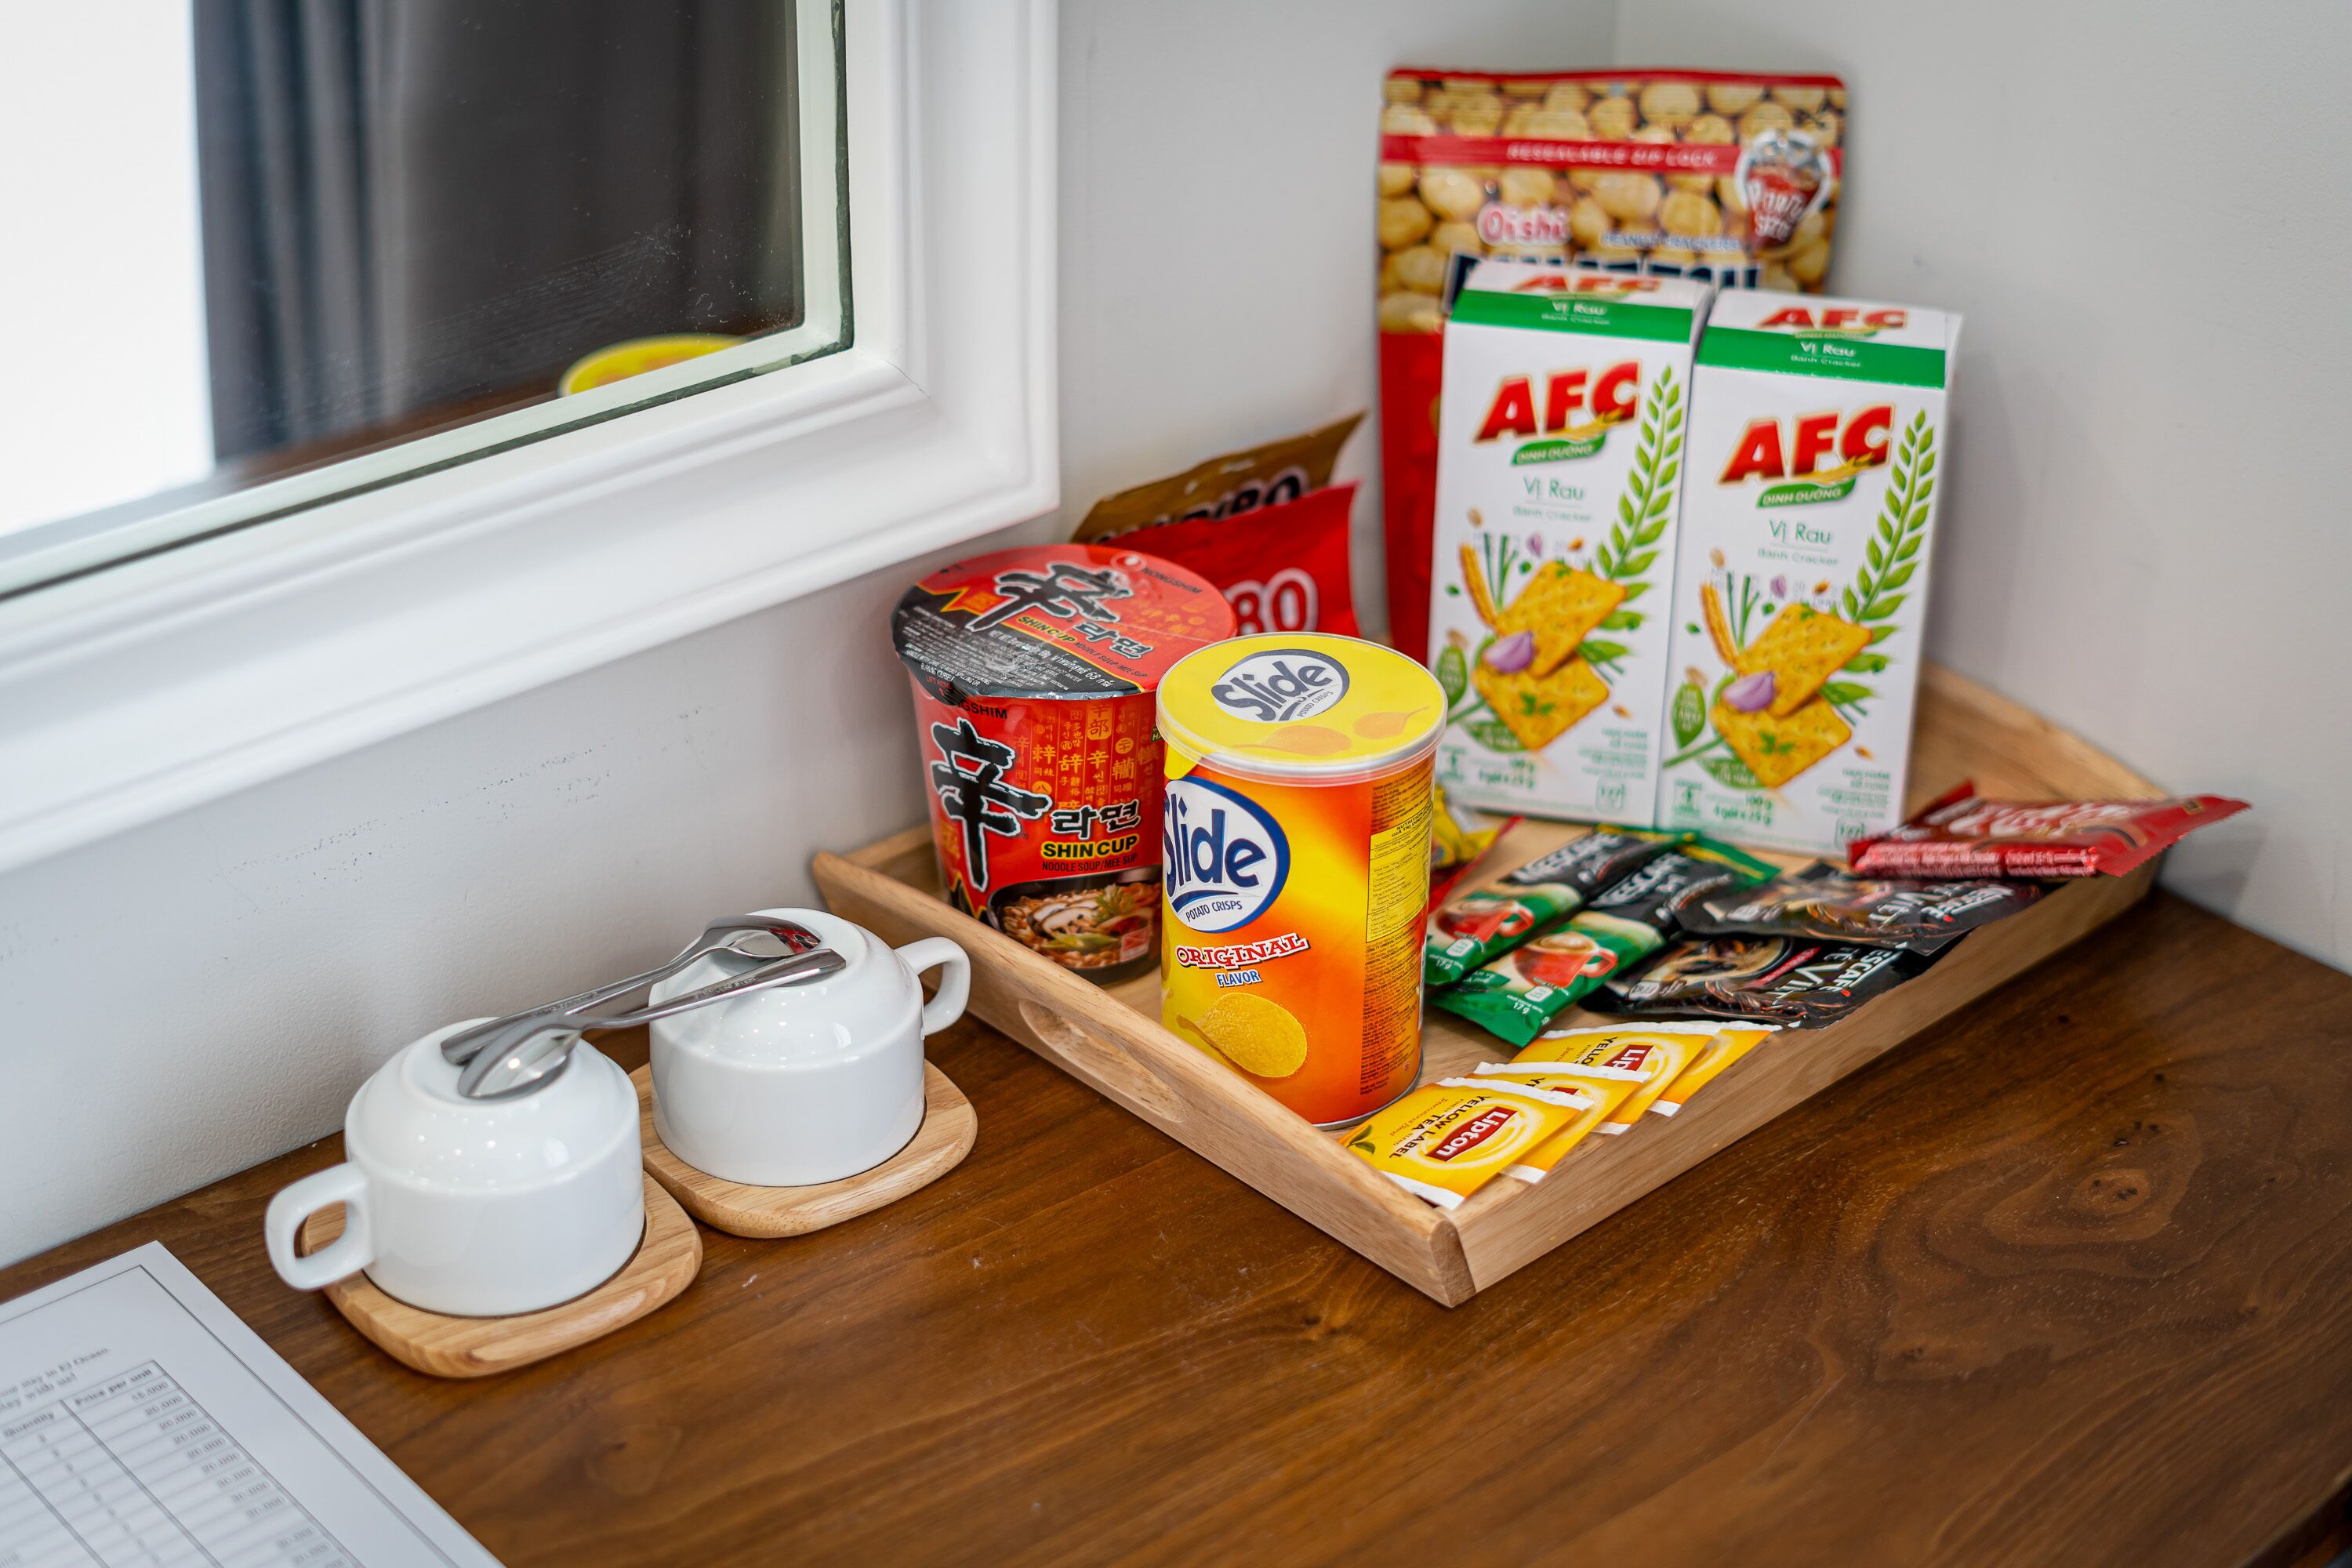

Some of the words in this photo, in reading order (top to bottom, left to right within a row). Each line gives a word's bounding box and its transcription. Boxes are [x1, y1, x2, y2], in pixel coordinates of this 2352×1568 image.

[1479, 205, 1570, 245] Oishi
[1573, 302, 1606, 315] Rau
[1758, 307, 1907, 328] AFC
[1823, 343, 1856, 358] Rau
[1473, 360, 1643, 442] AFC
[1716, 401, 1895, 487] AFC
[1523, 476, 1541, 501] Vị
[1548, 478, 1584, 500] Rau
[1769, 517, 1787, 543] Vị
[1795, 521, 1831, 545] Rau
[1142, 567, 1203, 595] NONGSHIM
[1017, 615, 1050, 633] SHIN
[1047, 627, 1077, 644] CUP
[1073, 641, 1101, 659] NOODLE
[1211, 660, 1334, 721] Slide
[1297, 701, 1315, 717] POTATO
[1312, 690, 1334, 704] CRISPS
[931, 716, 1052, 893] 辛
[1051, 799, 1141, 840] 라면
[1041, 841, 1096, 859] SHIN
[1096, 833, 1140, 857] CUP
[1164, 793, 1267, 898] Slide
[1042, 860, 1076, 873] NOODLE
[1185, 903, 1210, 923] POTATO
[1211, 900, 1243, 913] CRISPS
[1176, 935, 1308, 968] ORIGINAL
[1216, 970, 1261, 987] FLAVOR
[1818, 948, 1894, 997] ESCAFÉ
[1614, 1048, 1646, 1071] Lip
[1411, 1113, 1446, 1131] TEA
[1431, 1094, 1493, 1130] YELLOW
[1388, 1131, 1436, 1159] LABEL
[1436, 1111, 1510, 1156] Lipton
[74, 1388, 106, 1406] Price
[107, 1378, 129, 1395] per
[130, 1367, 153, 1382] unit
